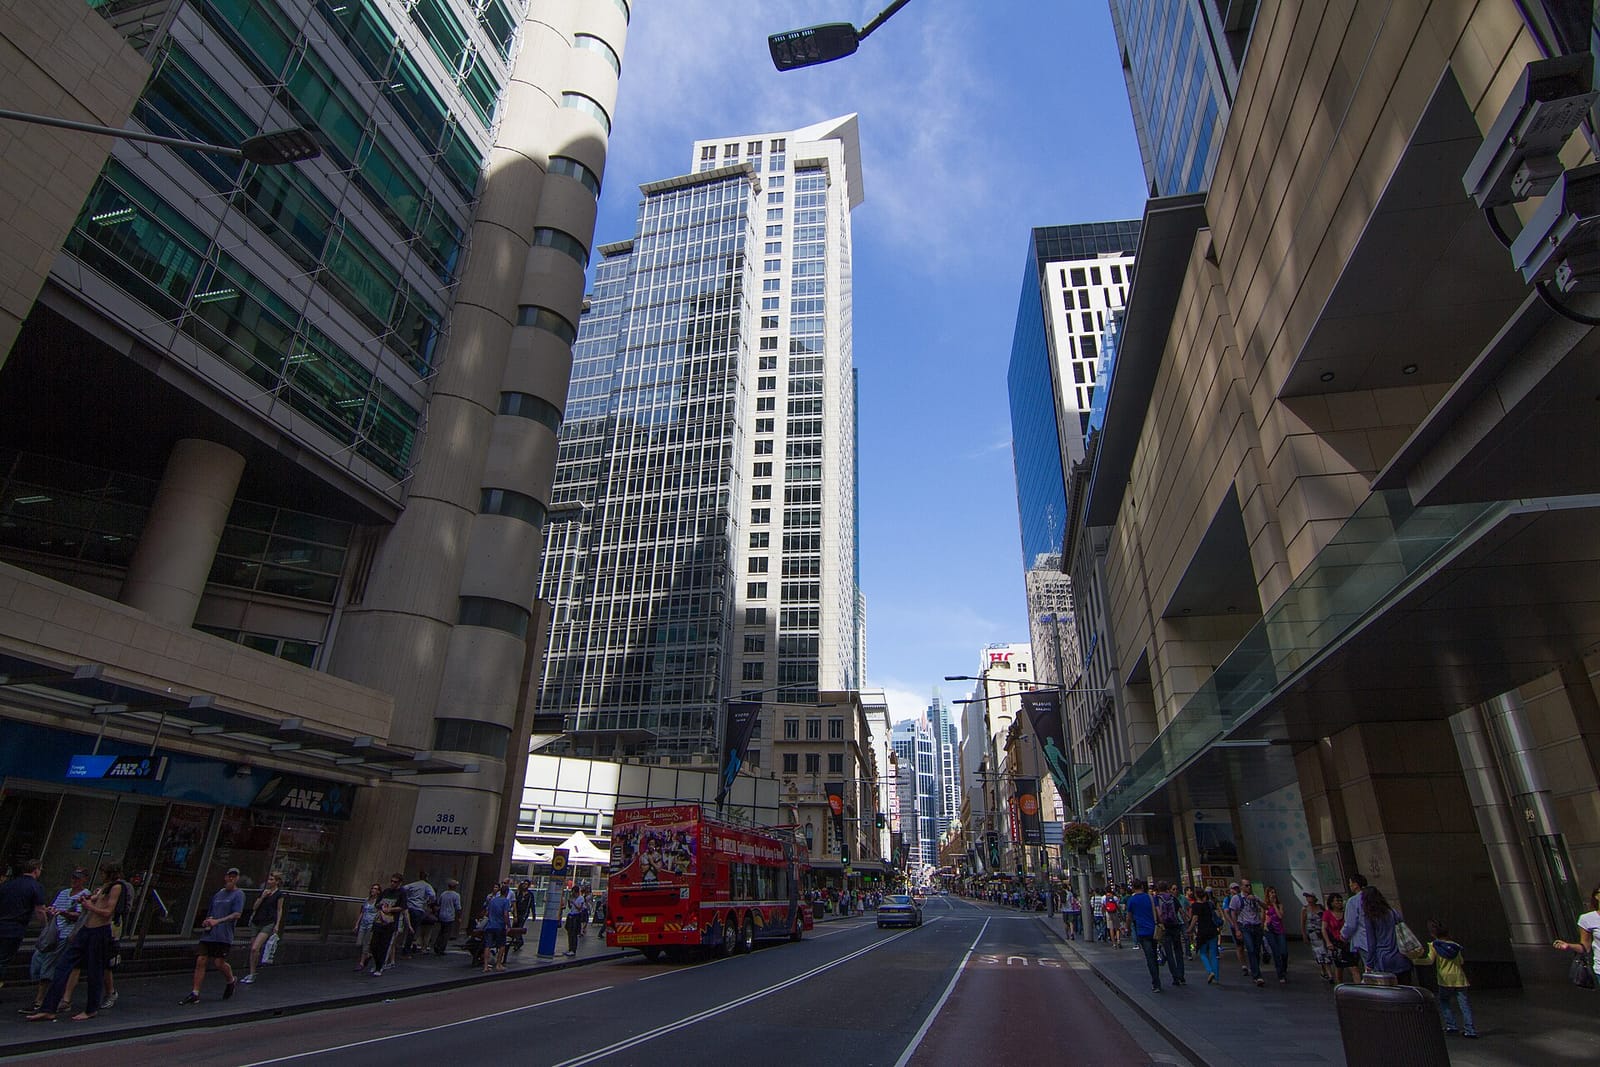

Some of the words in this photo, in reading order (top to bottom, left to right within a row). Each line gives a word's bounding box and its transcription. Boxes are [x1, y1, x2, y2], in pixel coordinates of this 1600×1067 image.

[110, 763, 138, 775] ANZ
[280, 788, 325, 811] ANZ
[436, 813, 455, 823] 388
[416, 825, 468, 836] COMPLEX
[1206, 879, 1226, 887] FOR
